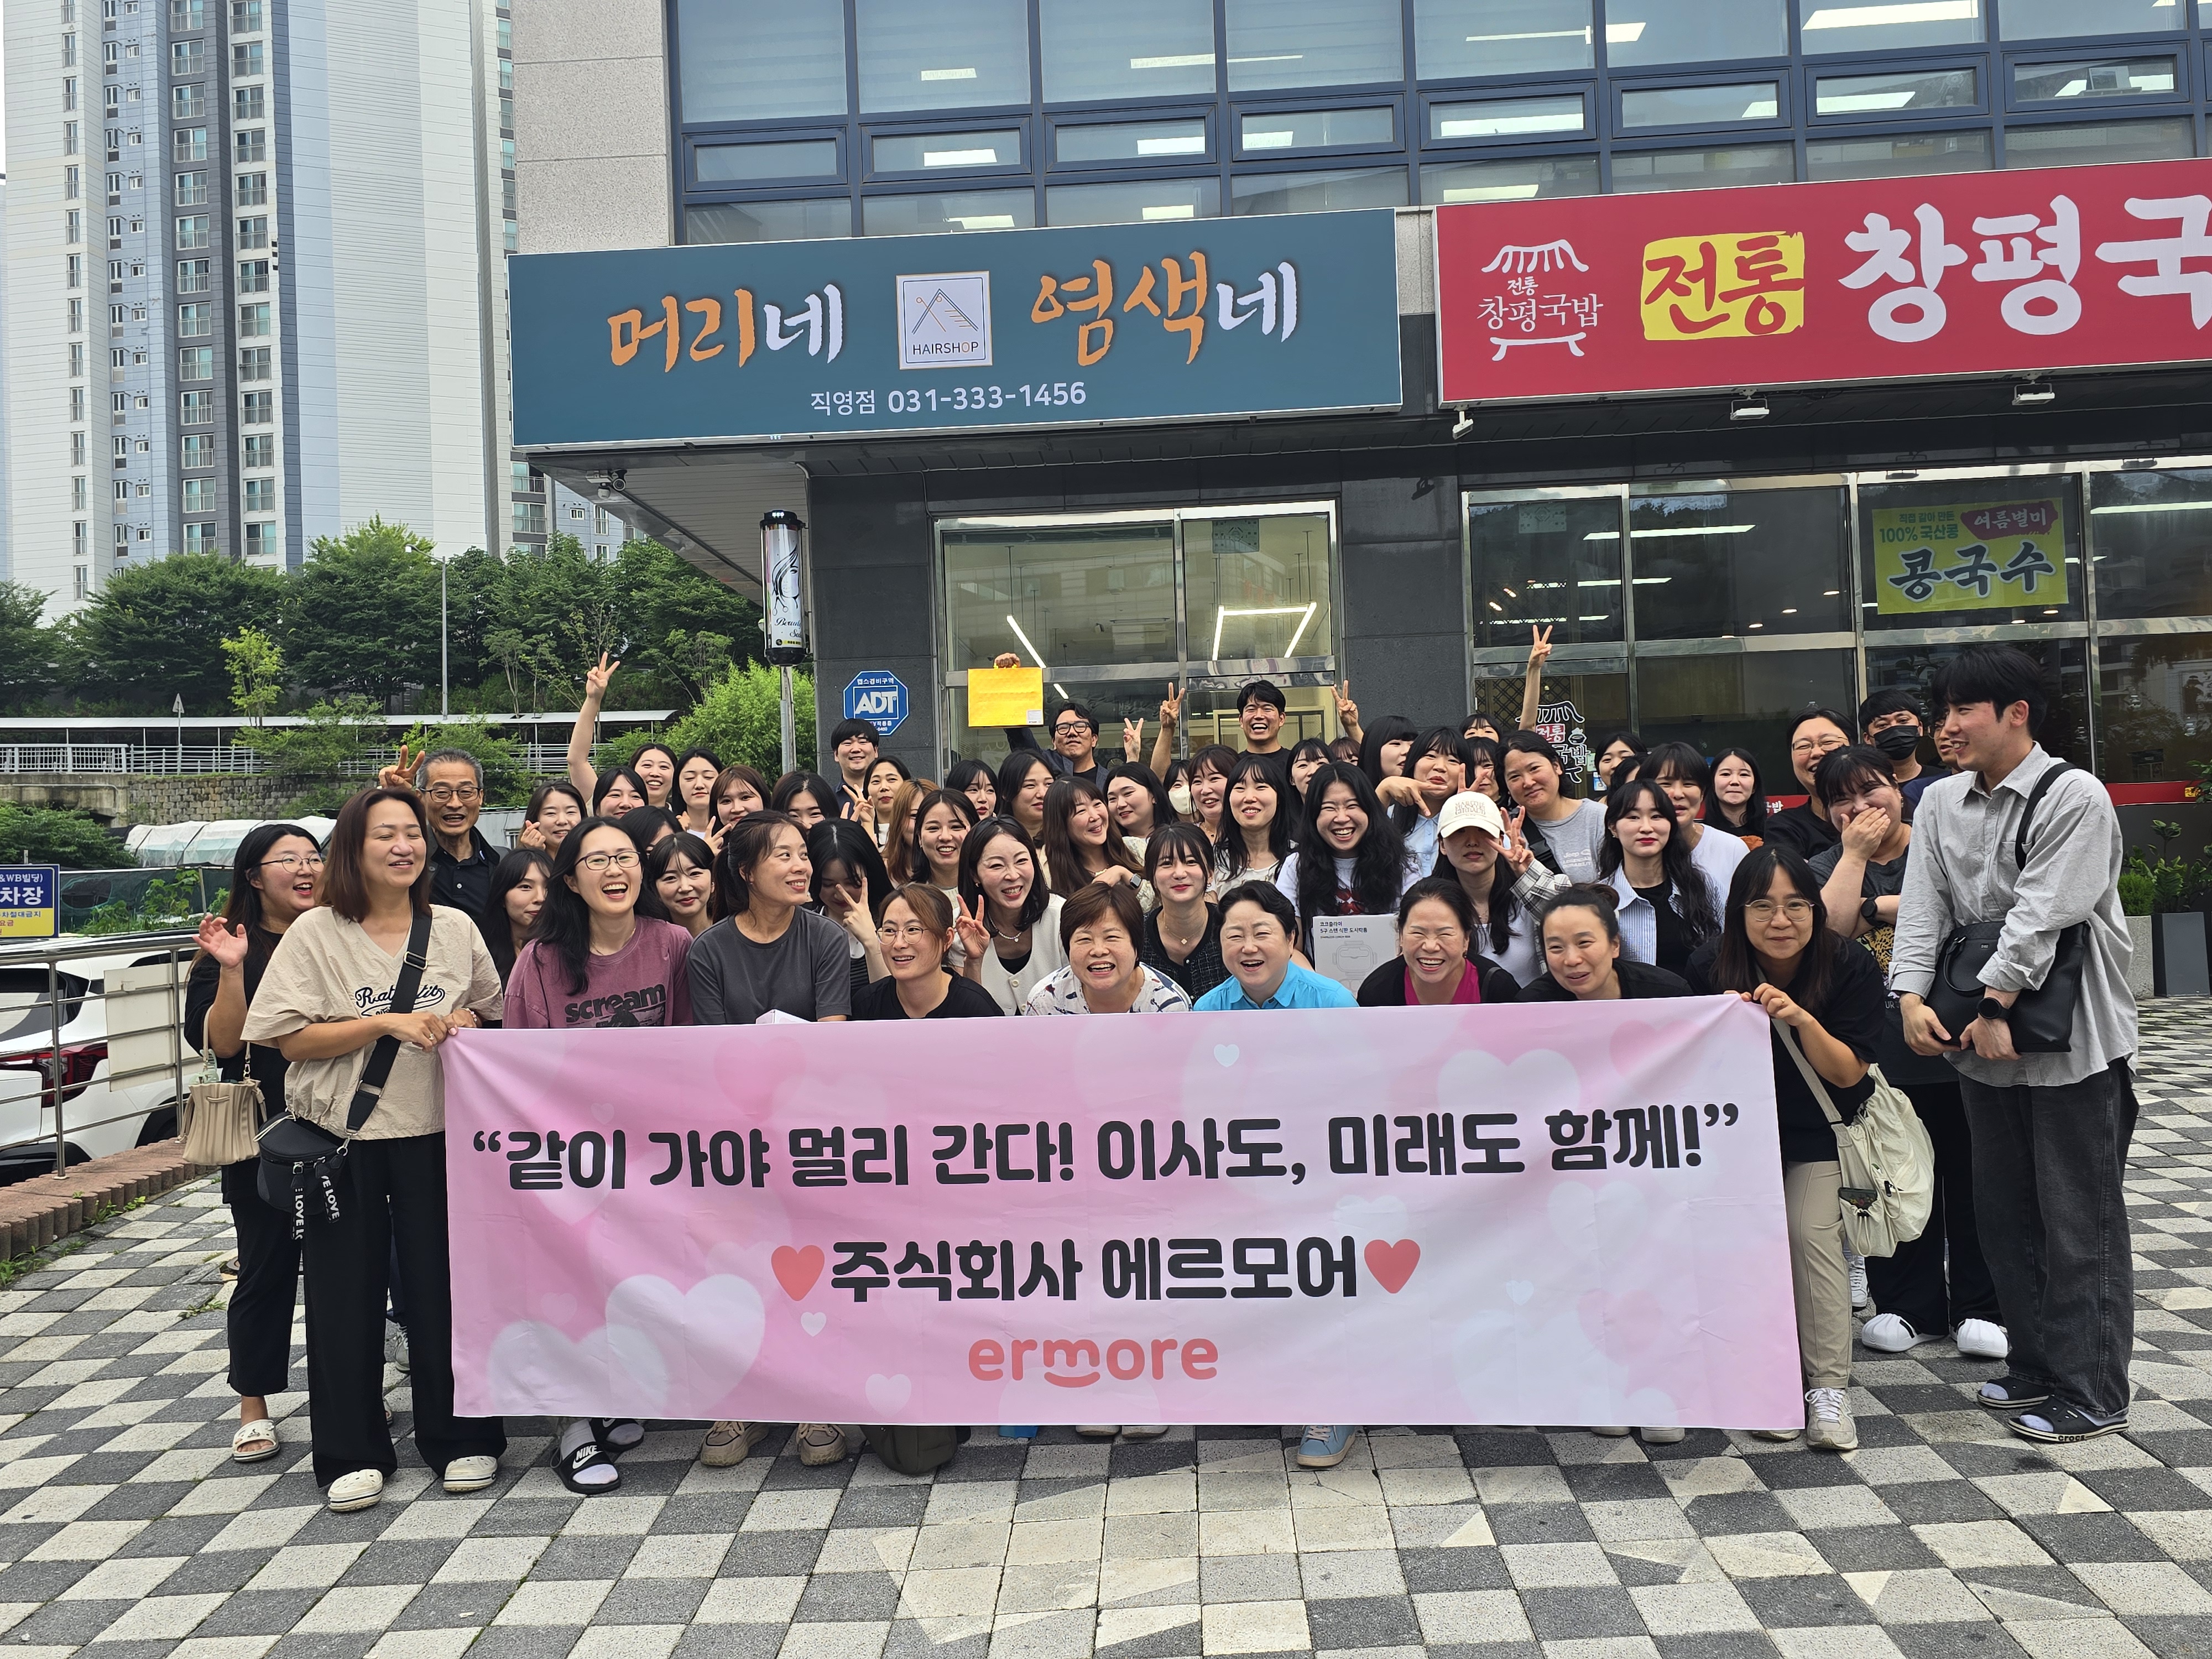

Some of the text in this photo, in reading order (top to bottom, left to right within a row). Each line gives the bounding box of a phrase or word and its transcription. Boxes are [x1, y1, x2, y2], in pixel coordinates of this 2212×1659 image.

[1507, 276, 1539, 295] 전통
[1645, 233, 1804, 335] 전통
[608, 252, 1297, 372] 머리네 염색네
[1477, 294, 1604, 330] 창평국밥
[912, 341, 979, 356] HAIRSHOP
[811, 382, 1087, 416] 직영점 031-333-1456
[1880, 524, 1959, 543] 100% 국산콩
[1899, 513, 1916, 524] 직접
[1974, 508, 2047, 530] 여름별미
[1889, 541, 2054, 600] 콩국수
[854, 691, 898, 714] ADT
[1537, 725, 1566, 742] 전통
[565, 984, 666, 1023] scream
[649, 1128, 771, 1188] 가야
[789, 1125, 909, 1187] 멀리
[933, 1121, 1074, 1185] 간다!
[1098, 1118, 1306, 1185] 이사도,
[1328, 1113, 1525, 1176] 미래도
[295, 1194, 304, 1227] LOVE
[325, 1188, 340, 1219] LOVE
[831, 1235, 1357, 1302] 주식회사 에르모어
[968, 1339, 1217, 1386] ermore
[576, 1445, 597, 1461] NIKE
